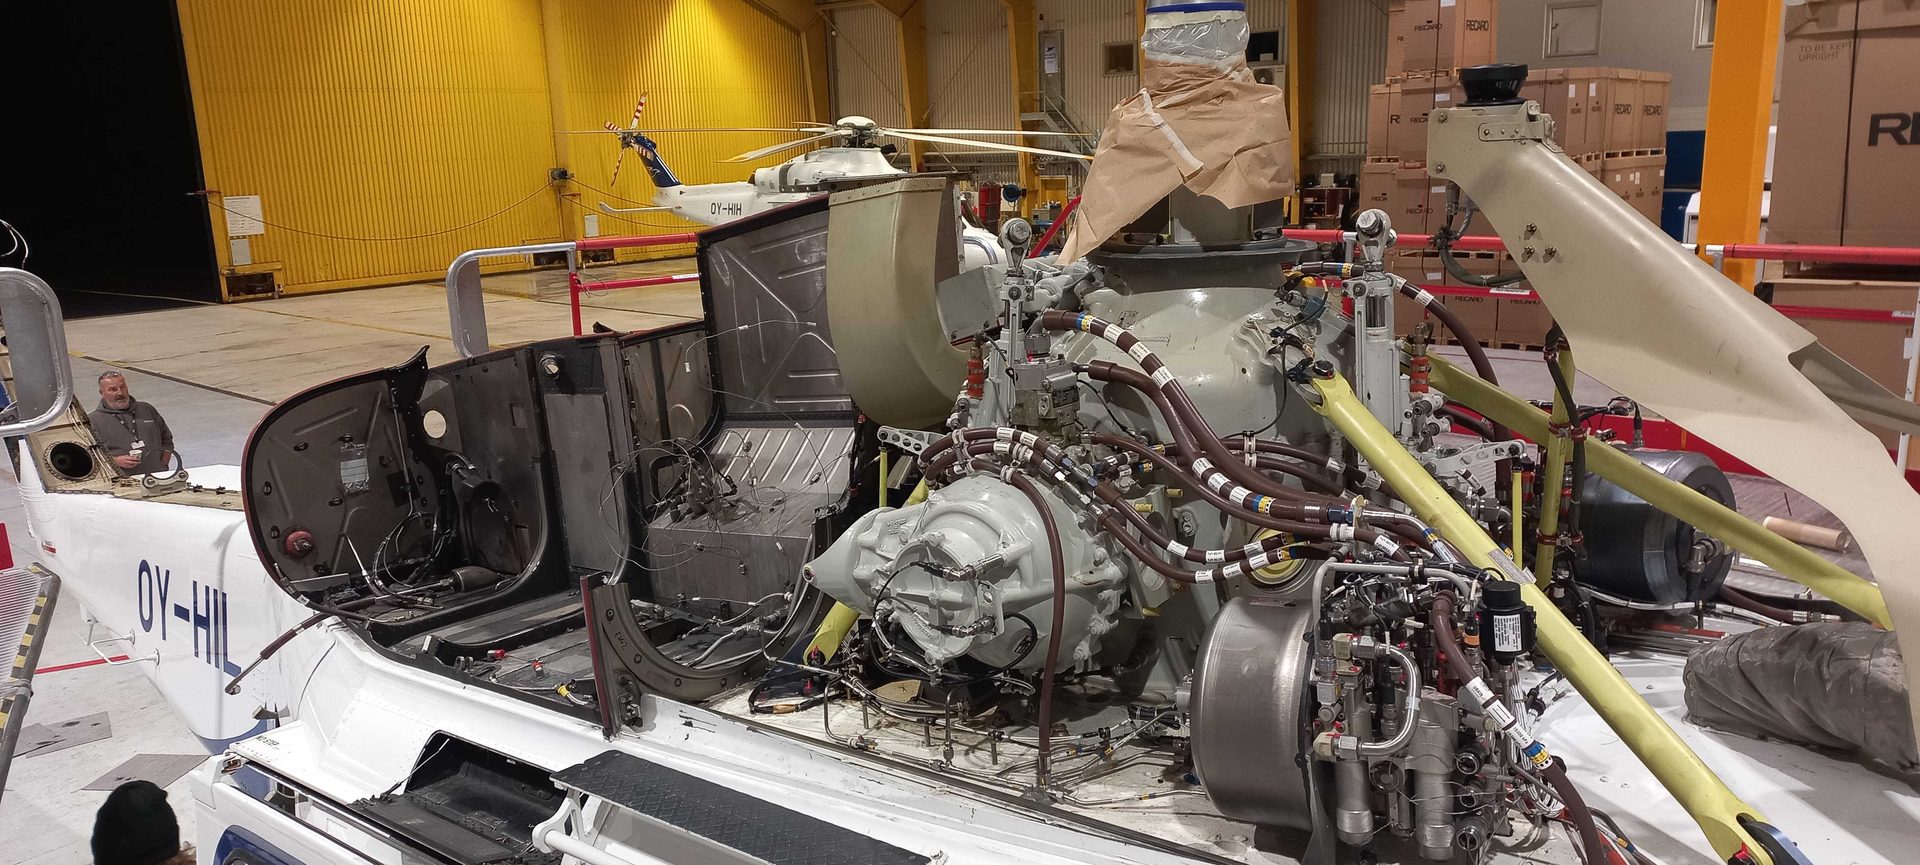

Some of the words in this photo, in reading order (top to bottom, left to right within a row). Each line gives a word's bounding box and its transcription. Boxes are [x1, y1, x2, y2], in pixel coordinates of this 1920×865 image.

[1414, 23, 1443, 32] RECARO
[1466, 20, 1489, 31] RECARO
[710, 202, 742, 216] OY-HIH
[138, 559, 241, 678] OY-HIL
